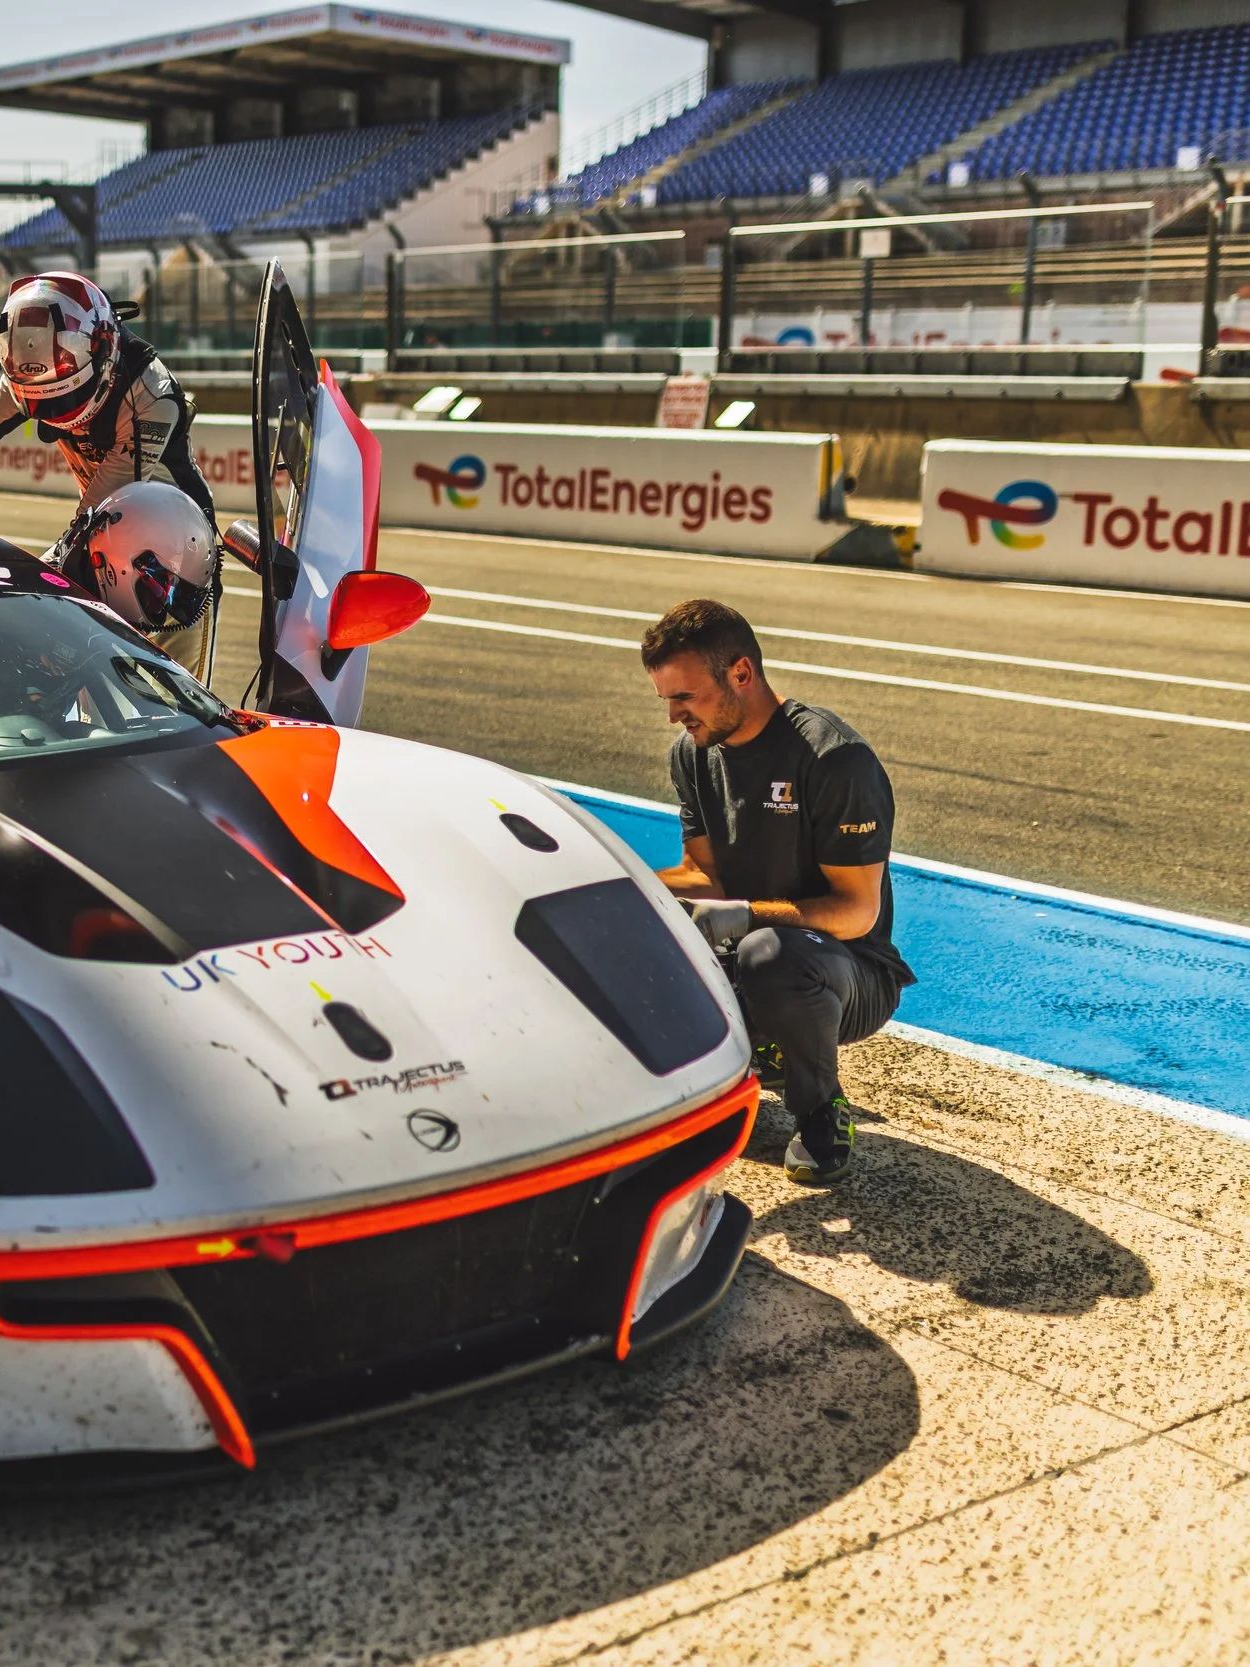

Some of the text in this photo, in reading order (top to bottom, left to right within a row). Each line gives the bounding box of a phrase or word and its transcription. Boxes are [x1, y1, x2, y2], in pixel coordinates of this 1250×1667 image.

[493, 462, 774, 532] TotalEnergies
[839, 821, 877, 834] TEAM
[160, 934, 393, 992] UK YOUTH
[354, 1061, 466, 1091] TRAJECTUS
